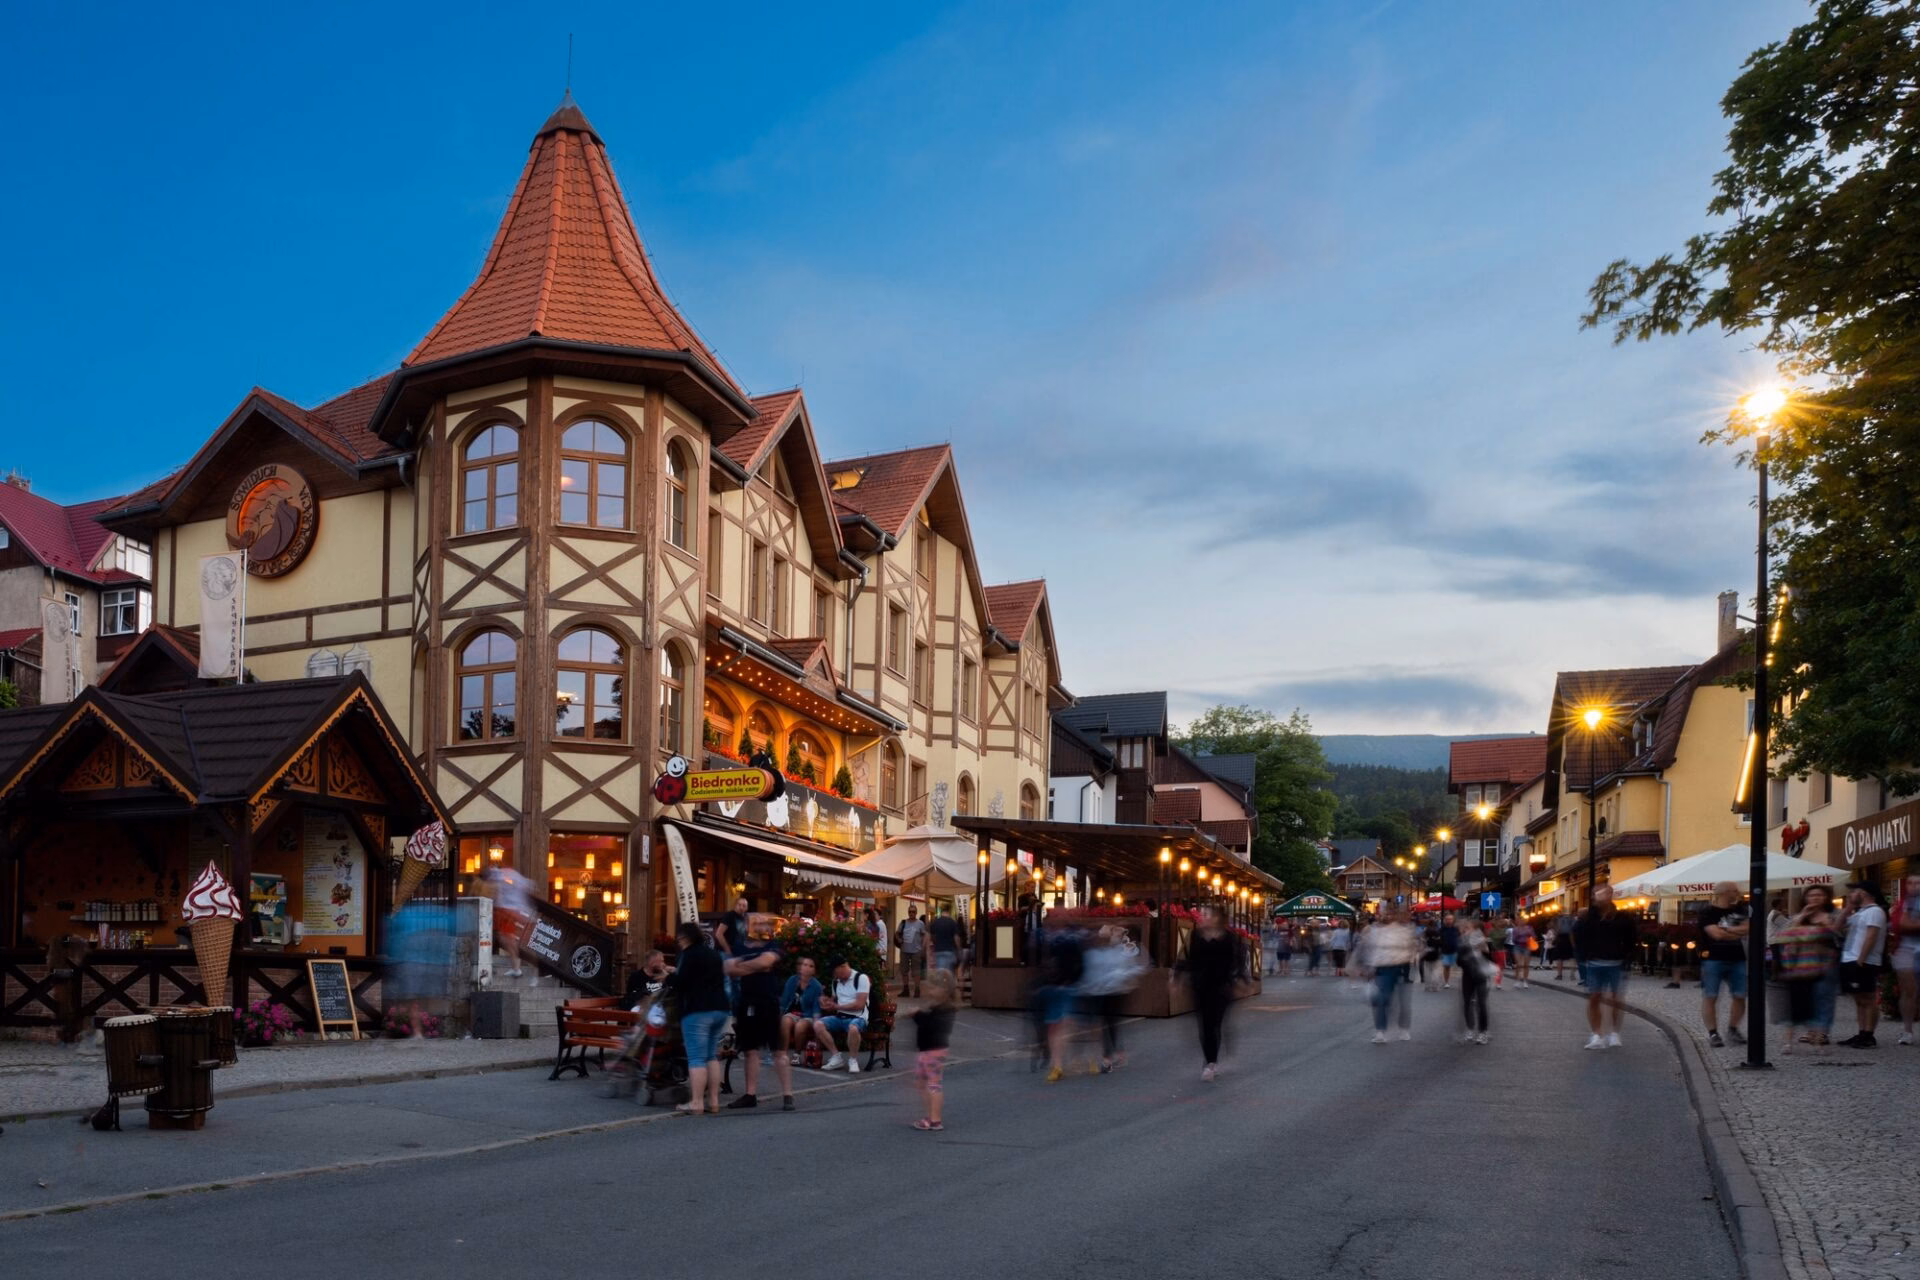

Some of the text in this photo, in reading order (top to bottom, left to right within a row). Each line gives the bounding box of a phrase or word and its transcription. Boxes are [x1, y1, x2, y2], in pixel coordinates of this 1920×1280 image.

[231, 466, 277, 511] SOWIDUCH
[691, 774, 760, 789] Biedronka
[691, 786, 759, 796] Codziennie niskie ceny
[1858, 814, 1911, 856] PAMIĄTKI
[1792, 874, 1833, 886] TYSKIE
[1676, 883, 1716, 893] TYSKIE
